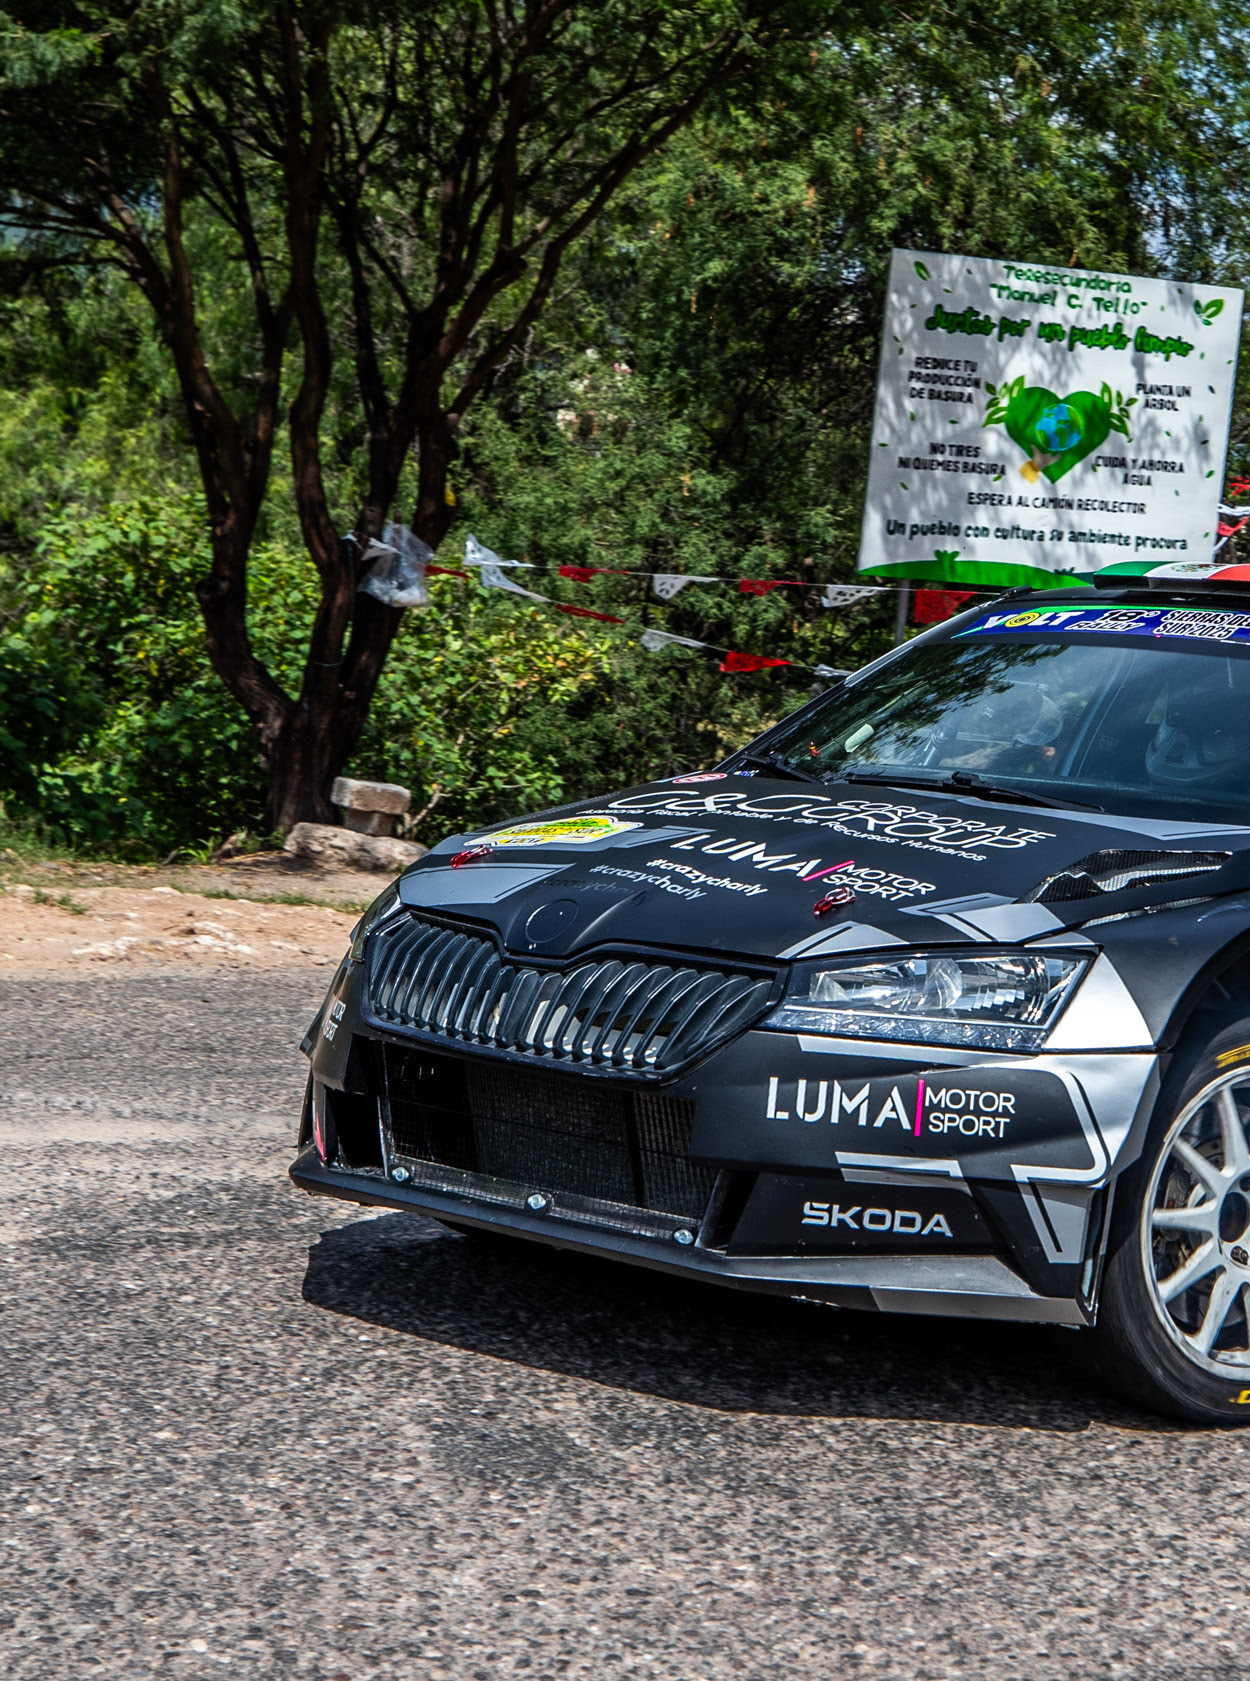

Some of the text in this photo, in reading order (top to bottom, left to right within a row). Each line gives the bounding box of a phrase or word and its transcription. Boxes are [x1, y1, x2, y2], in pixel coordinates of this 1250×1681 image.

[1003, 264, 1132, 293] Telesecundaria
[998, 316, 1031, 342] por
[1038, 322, 1066, 343] un
[1068, 322, 1131, 351] pueblo
[1134, 326, 1194, 361] limpio
[915, 357, 978, 372] REDUCE TU
[908, 371, 981, 389] PRODUCCIÓN
[1136, 383, 1192, 397] PLANTA UN
[910, 387, 973, 404] DE BASURA
[929, 442, 980, 458] NO TIRES
[898, 457, 1006, 475] NI QUEMES BASURA
[1095, 455, 1185, 473] CUIDA Y AHORRA
[1122, 473, 1152, 486] AGUA
[968, 492, 1147, 515] ESPERA AL CAMIÓN RECOLECTOR
[886, 520, 906, 535] Un
[908, 520, 960, 540] pueblo
[965, 525, 989, 538] con
[994, 524, 1045, 542] cultura
[1068, 529, 1131, 546] ambiente
[1135, 535, 1188, 552] procura
[983, 611, 1085, 629] VOLT
[1065, 621, 1145, 631] RALLY
[1155, 622, 1236, 638] SUR 2025
[1162, 610, 1227, 625] SIERRAS
[802, 807, 1028, 849] GROUP
[837, 800, 1057, 843] CORPORATE
[793, 817, 819, 825] de
[821, 821, 899, 845] Recursos
[901, 839, 987, 862] Humanos
[670, 834, 821, 878] LUMA
[589, 864, 707, 901] #crazycharly
[646, 858, 768, 897] #crazycharly
[823, 873, 914, 901] SPORT
[837, 864, 937, 894] MOTOR
[766, 1076, 911, 1130] LUMA
[924, 1087, 1015, 1114] MOTOR
[928, 1112, 1010, 1138] SPORT
